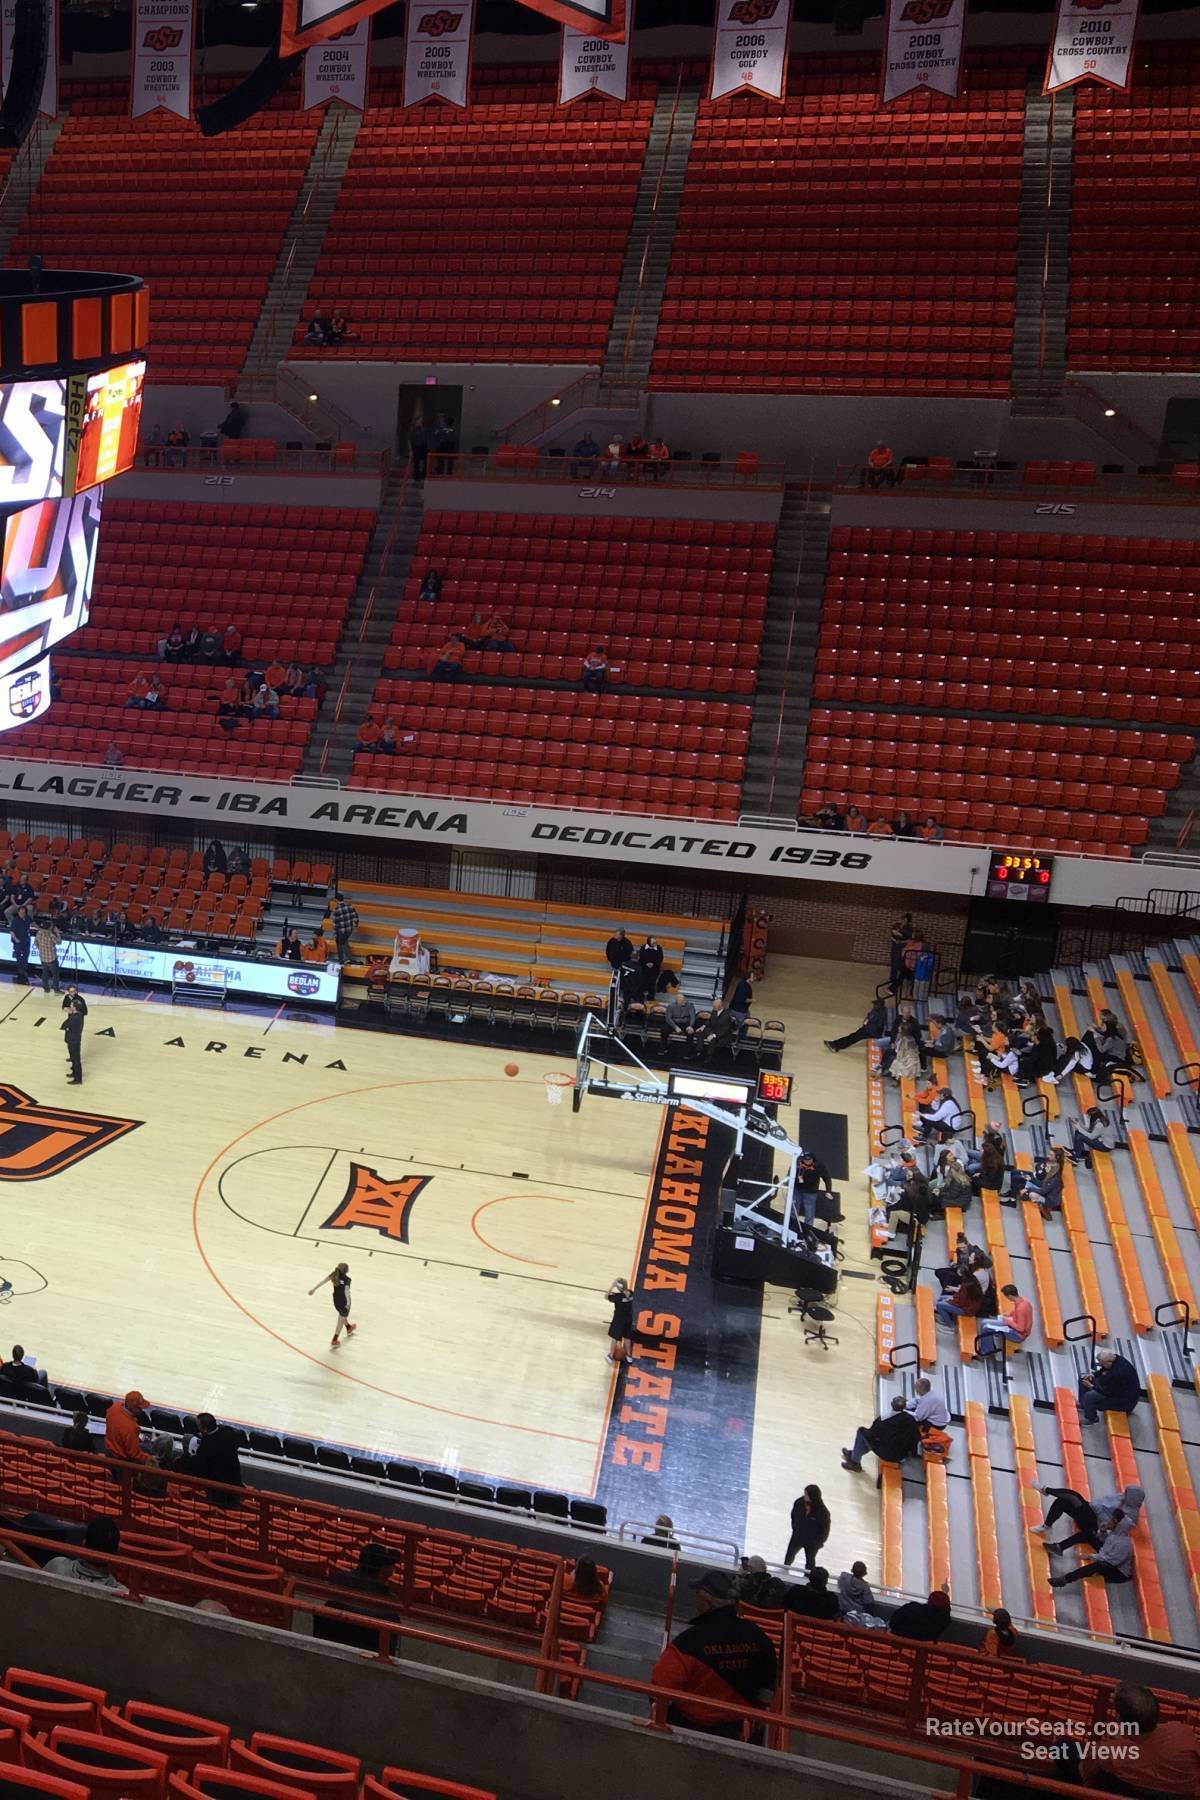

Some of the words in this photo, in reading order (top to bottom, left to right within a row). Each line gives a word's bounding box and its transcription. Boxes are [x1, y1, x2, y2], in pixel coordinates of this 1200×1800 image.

[138, 5, 189, 15] CHAMPIONS
[1079, 21, 1112, 33] 2010
[583, 40, 609, 51] 2006
[736, 35, 765, 47] 2006
[909, 34, 941, 47] 2009
[1072, 36, 1116, 46] COWBOY
[323, 51, 349, 61] 2004
[425, 47, 450, 57] 2005
[731, 50, 768, 59] COWBOY
[904, 49, 944, 60] COWBOY
[1057, 47, 1085, 56] CROSS
[1086, 46, 1128, 55] COUNTRY
[578, 54, 612, 63] COWBOY
[150, 61, 174, 71] 2003
[319, 64, 352, 73] COWBOY
[420, 61, 453, 69] COWBOY
[574, 64, 616, 72] WRESTLING
[738, 60, 757, 68] GOLF
[889, 61, 916, 70] CROSS
[918, 58, 956, 68] COUNTRY
[1084, 60, 1096, 69] 50
[316, 73, 355, 81] WRESTLING
[417, 70, 456, 78] WRESTLING
[590, 76, 599, 85] 47
[144, 83, 180, 91] WRESTLING
[68, 379, 84, 453] Hertz
[204, 475, 236, 485] 213
[580, 487, 616, 498] 214
[1036, 504, 1078, 514] 215
[308, 801, 468, 834] ARENA
[530, 822, 758, 859] DEDICATED
[769, 846, 873, 869] 1938
[289, 976, 320, 988] BEDLAM
[163, 1035, 348, 1072] ARENA
[763, 1074, 790, 1086] 33:57
[766, 1085, 784, 1098] 30
[611, 1310, 681, 1473] STATE
